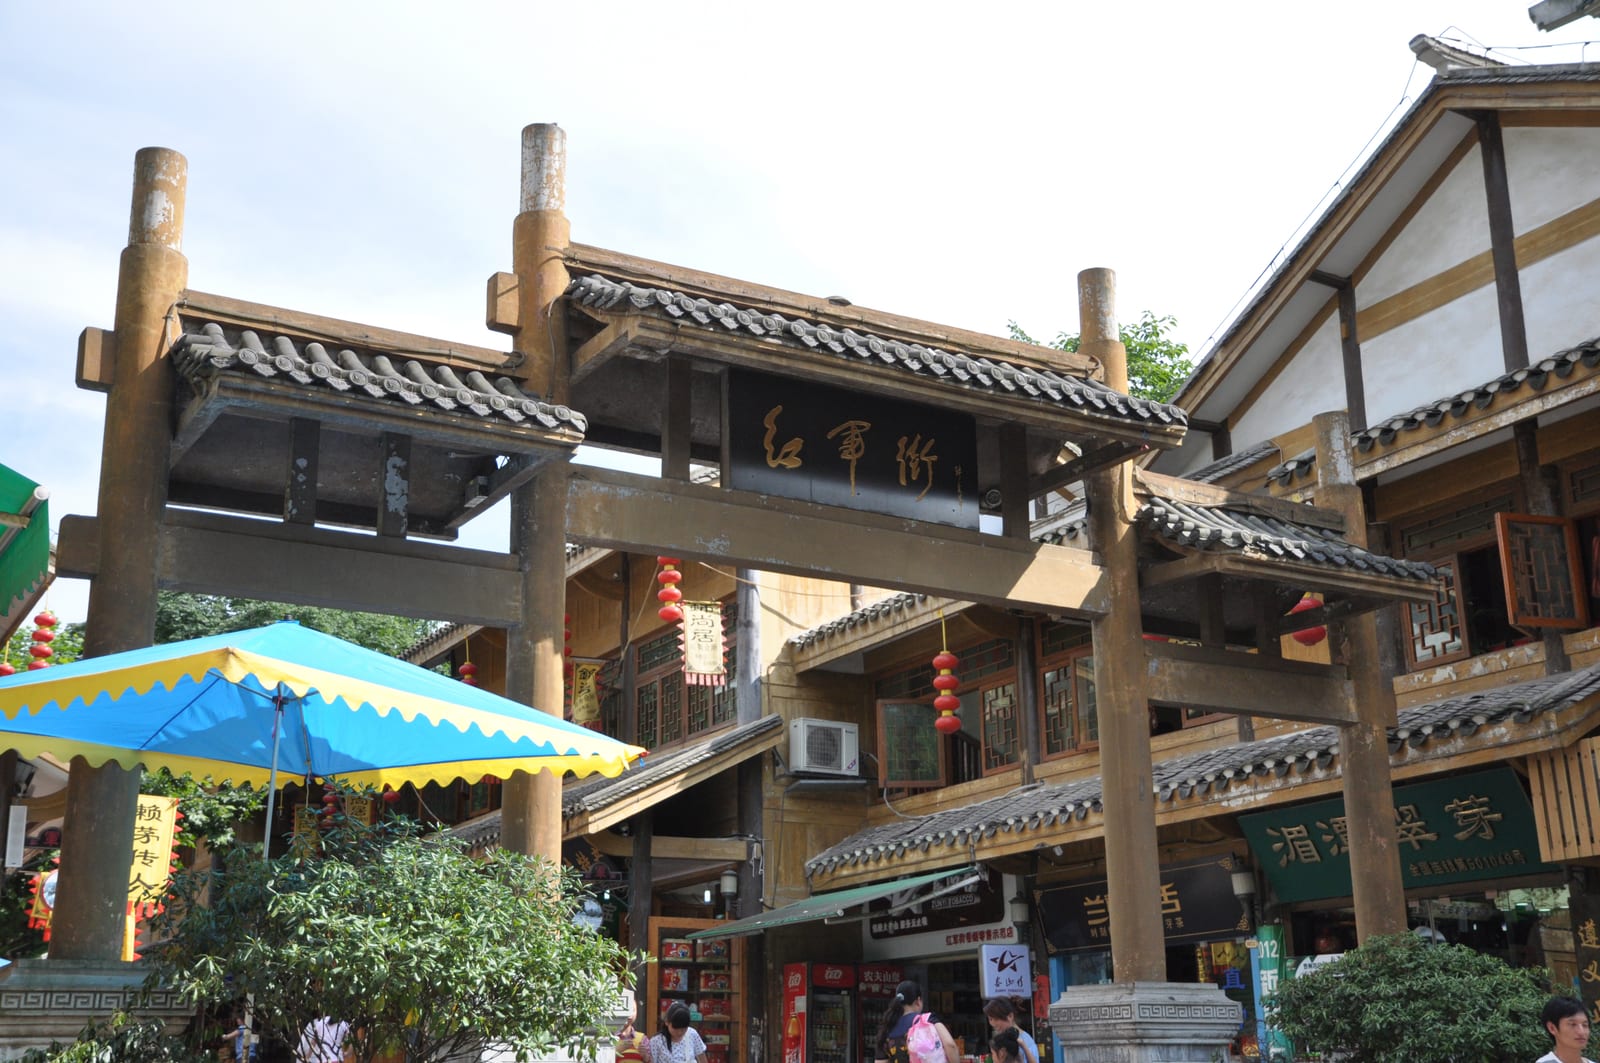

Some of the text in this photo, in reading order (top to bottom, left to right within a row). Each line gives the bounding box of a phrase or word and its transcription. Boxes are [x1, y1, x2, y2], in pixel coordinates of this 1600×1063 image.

[763, 404, 938, 502] 红军街
[129, 803, 163, 892] 赖茅传人
